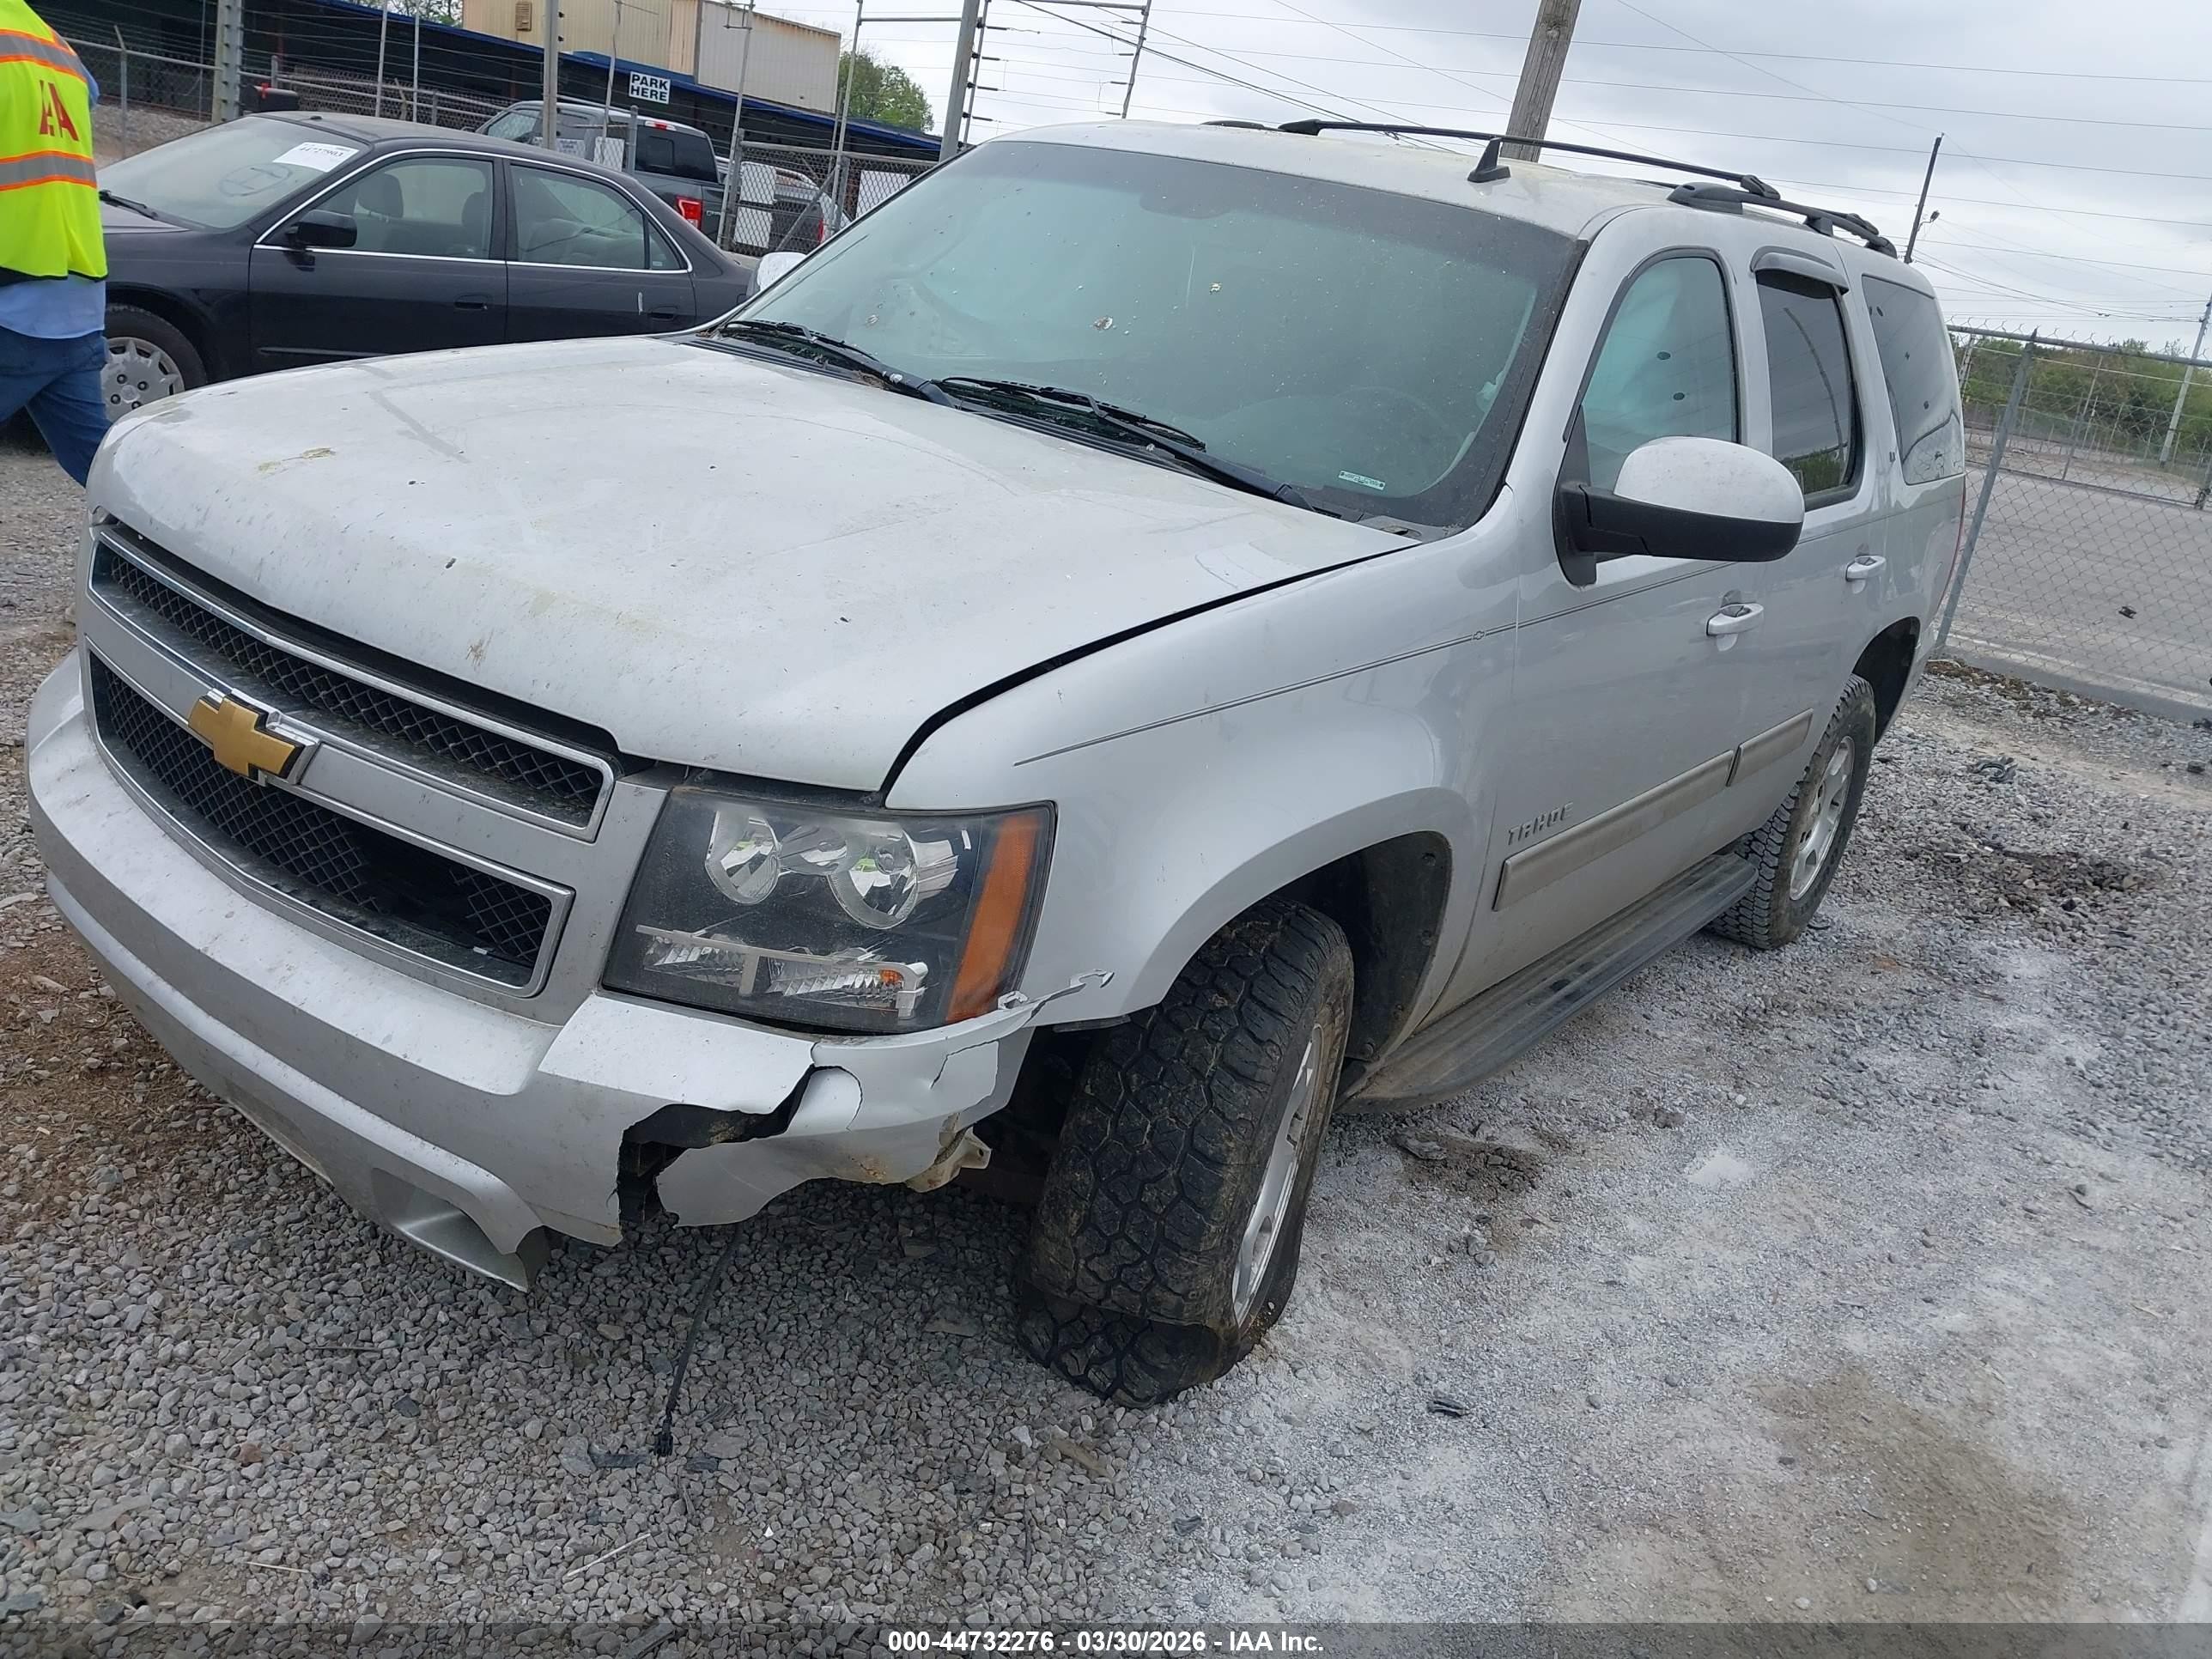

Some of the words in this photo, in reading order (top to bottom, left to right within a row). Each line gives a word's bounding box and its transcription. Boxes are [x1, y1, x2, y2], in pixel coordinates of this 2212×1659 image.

[631, 74, 669, 91] PARK
[630, 85, 667, 101] HERE
[1507, 800, 1574, 846] TAHOE
